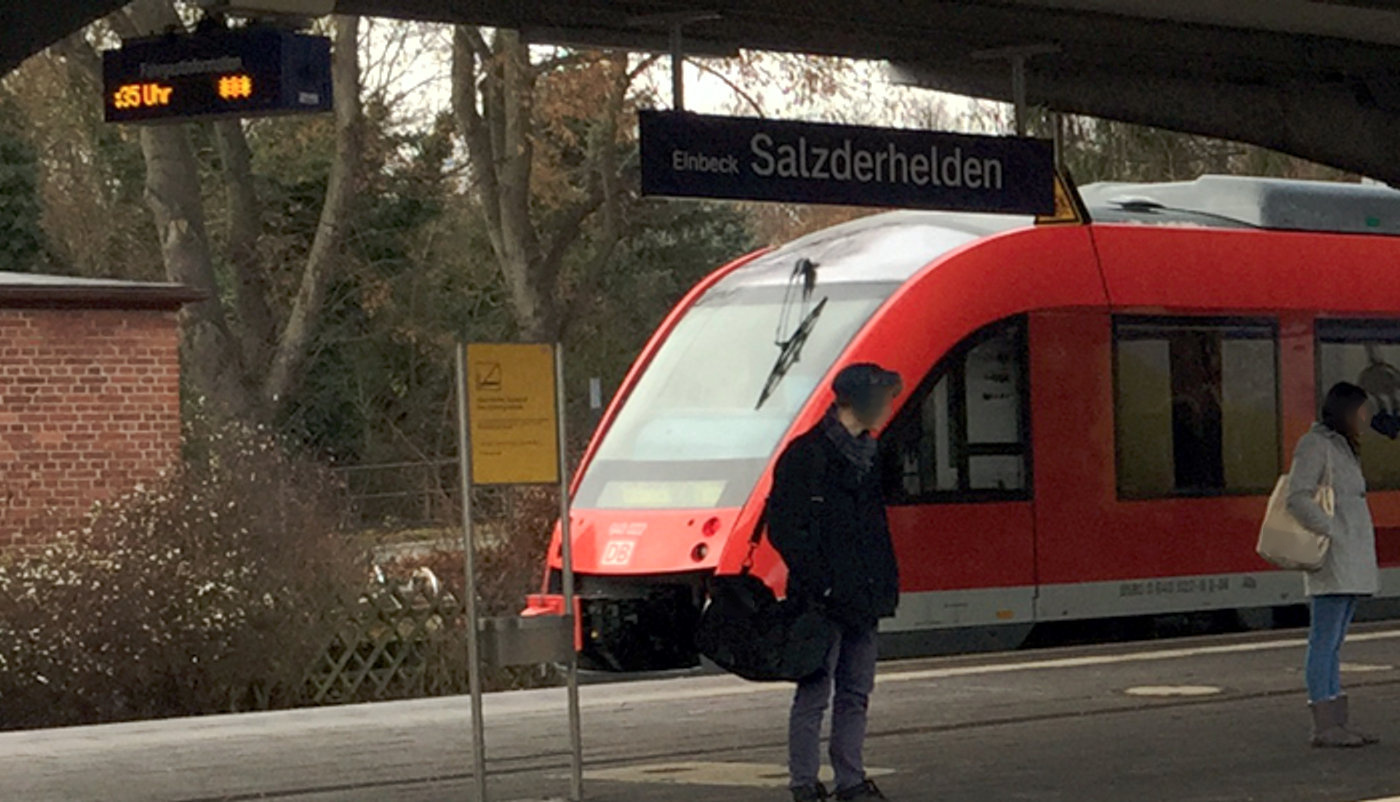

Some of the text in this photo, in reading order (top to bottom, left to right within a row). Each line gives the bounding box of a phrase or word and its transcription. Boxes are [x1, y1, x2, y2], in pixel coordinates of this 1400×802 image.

[143, 83, 173, 105] Uhr
[672, 133, 1003, 190] Einbeck Salzderhelden
[604, 542, 632, 563] DB
